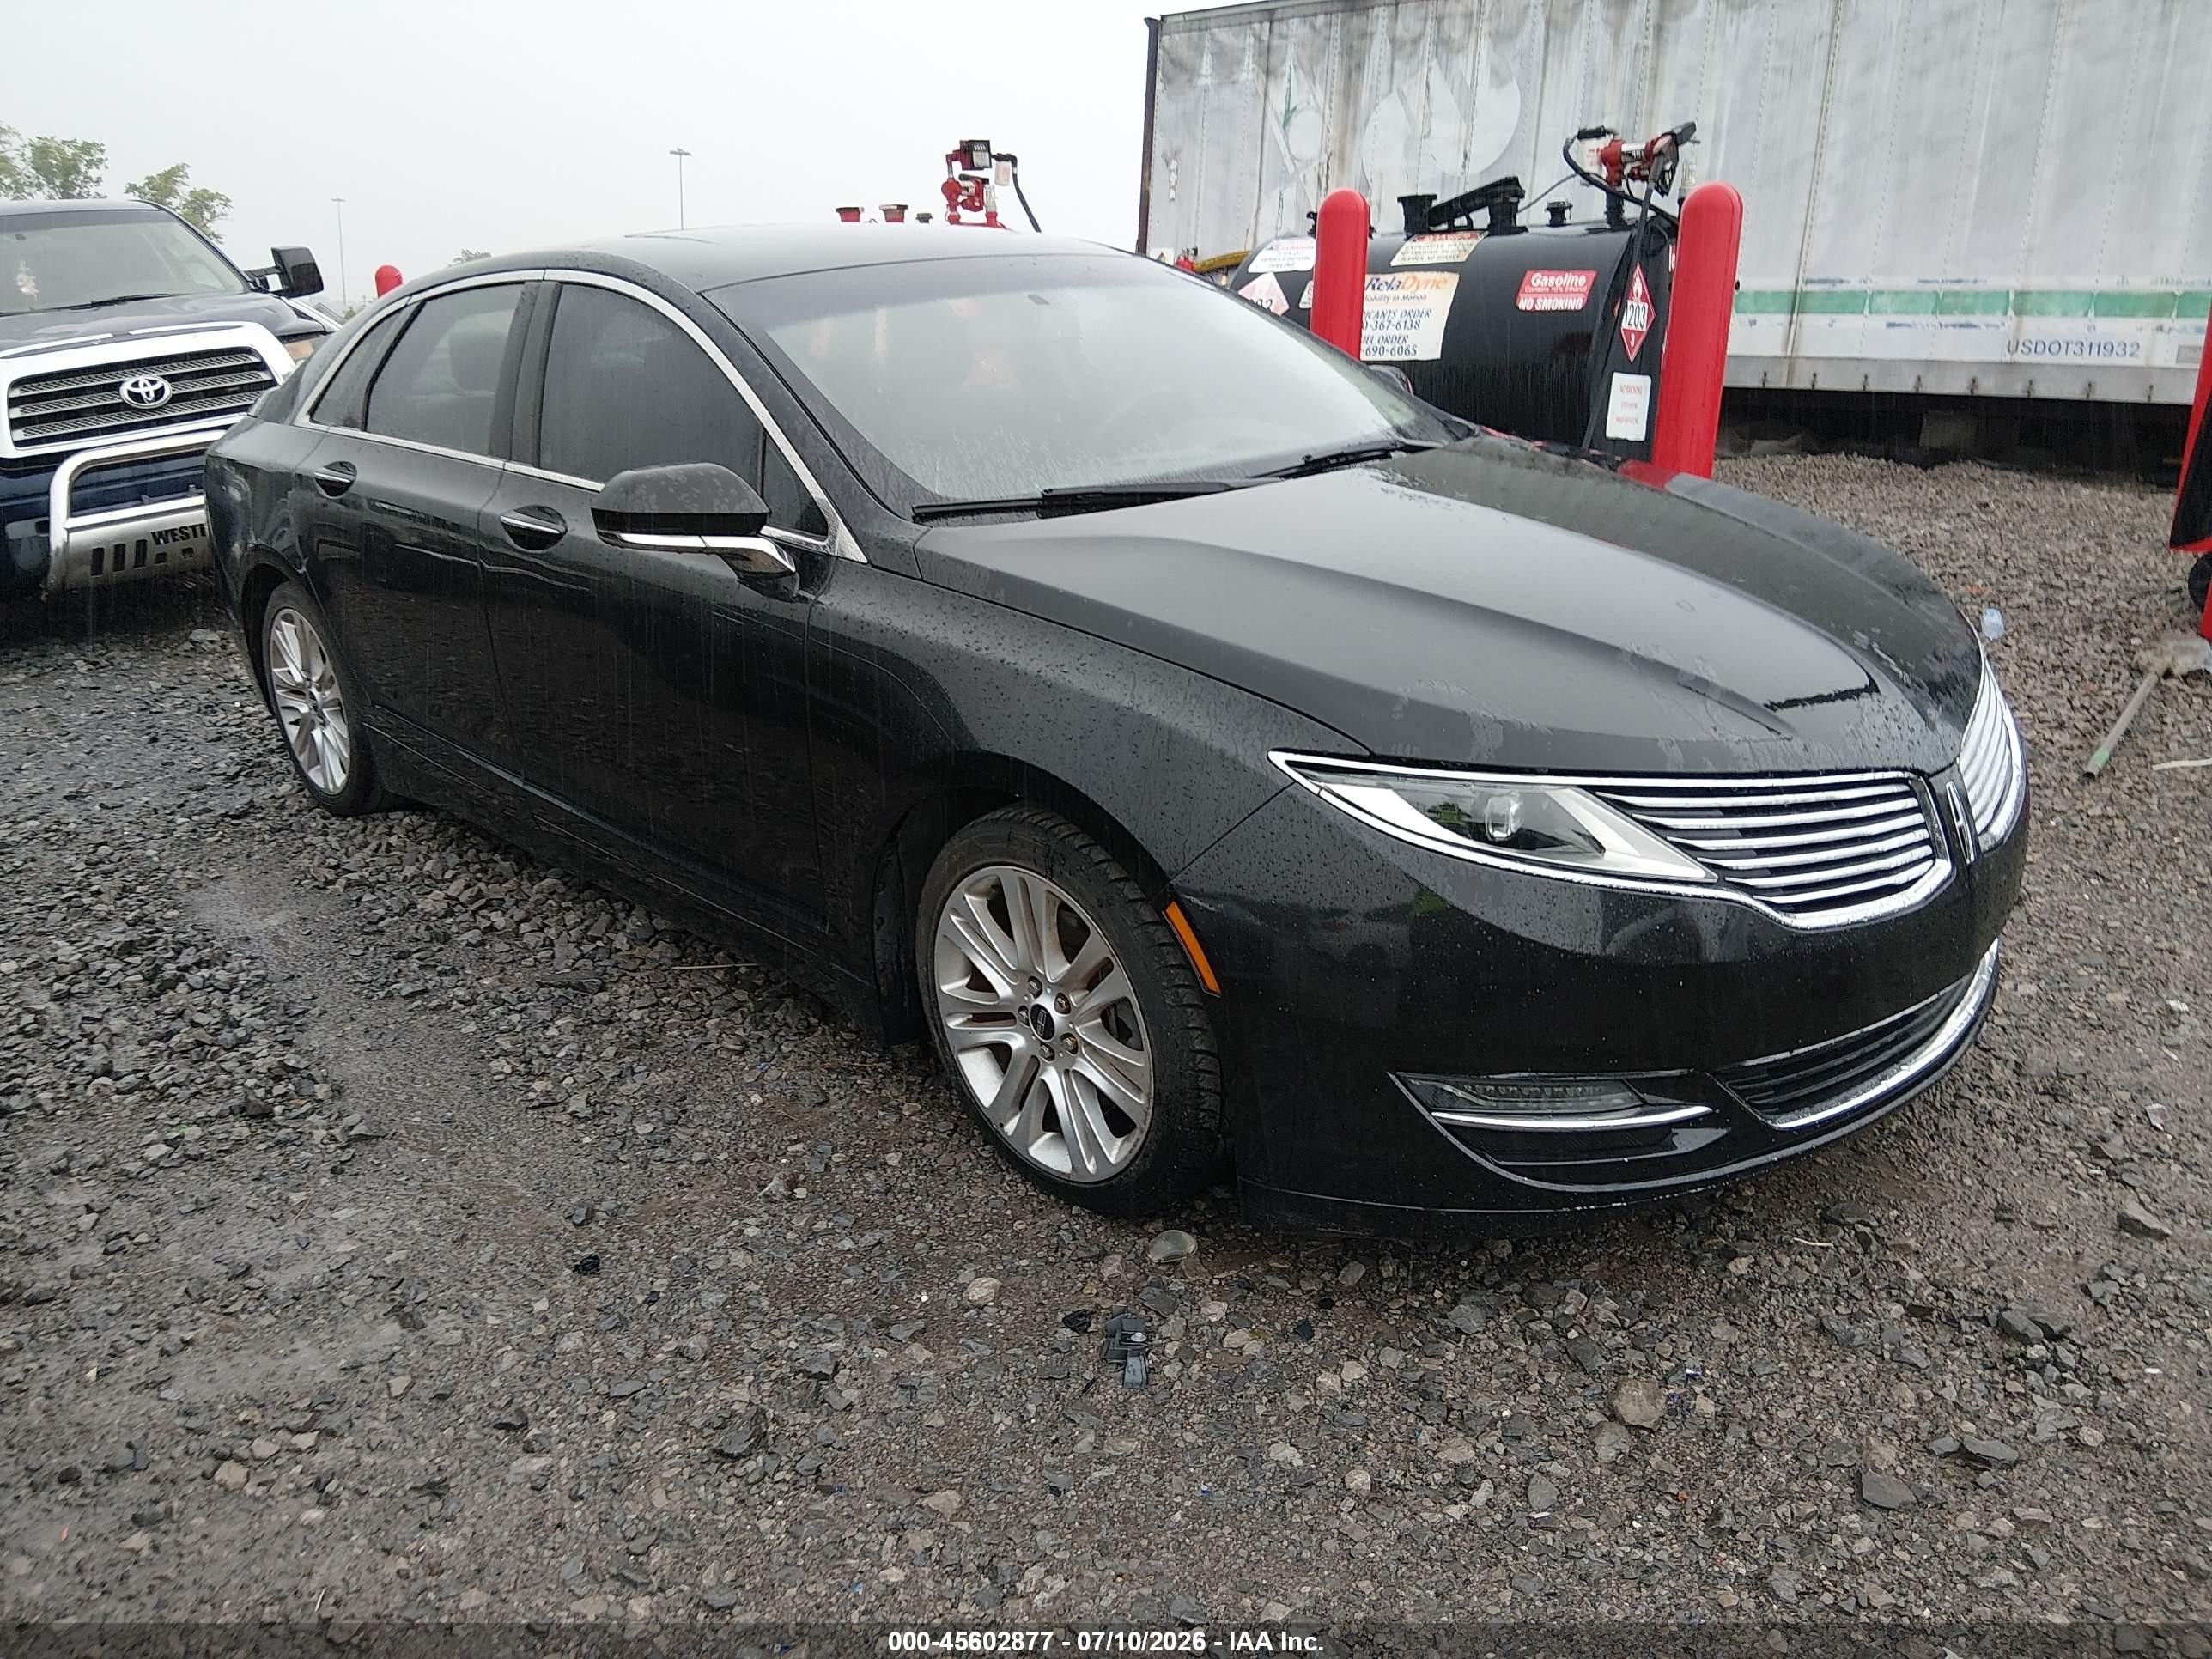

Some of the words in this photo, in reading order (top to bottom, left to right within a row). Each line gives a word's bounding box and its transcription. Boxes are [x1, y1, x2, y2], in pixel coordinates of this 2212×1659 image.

[1530, 272, 1587, 287] Gasoline
[1518, 296, 1534, 310] NO
[1534, 296, 1584, 310] SMOKING
[1400, 309, 1432, 319] ORDER
[1625, 303, 1646, 330] 1203
[1377, 334, 1409, 344] ORDER
[1630, 332, 1635, 348] 3
[2006, 338, 2141, 358] USDOT311932
